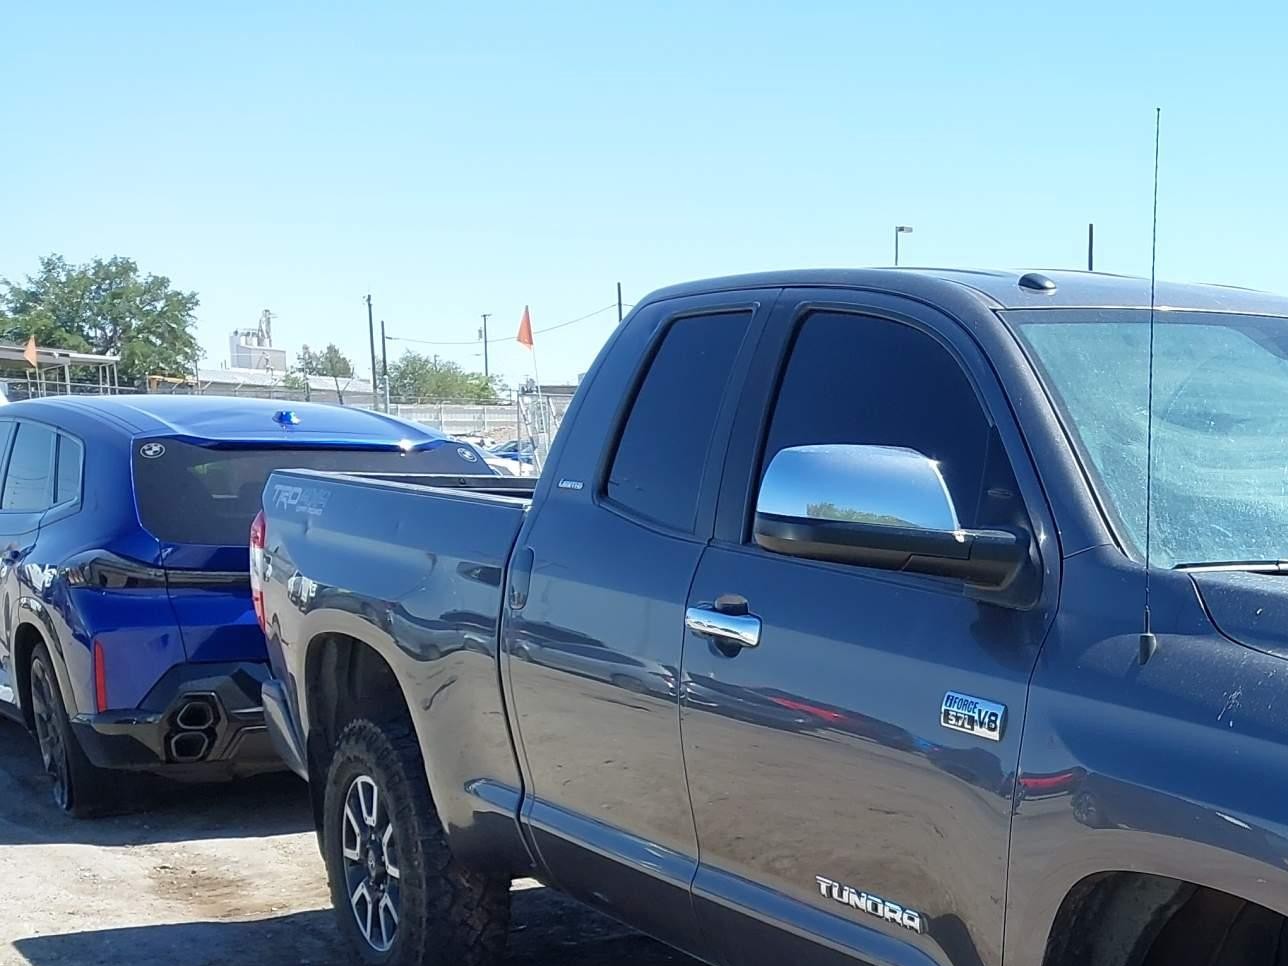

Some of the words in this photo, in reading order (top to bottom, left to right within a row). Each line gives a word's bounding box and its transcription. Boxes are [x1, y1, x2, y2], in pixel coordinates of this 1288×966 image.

[948, 710, 972, 730] 5.7L
[977, 707, 999, 732] V8
[815, 875, 922, 934] TUNDRA
